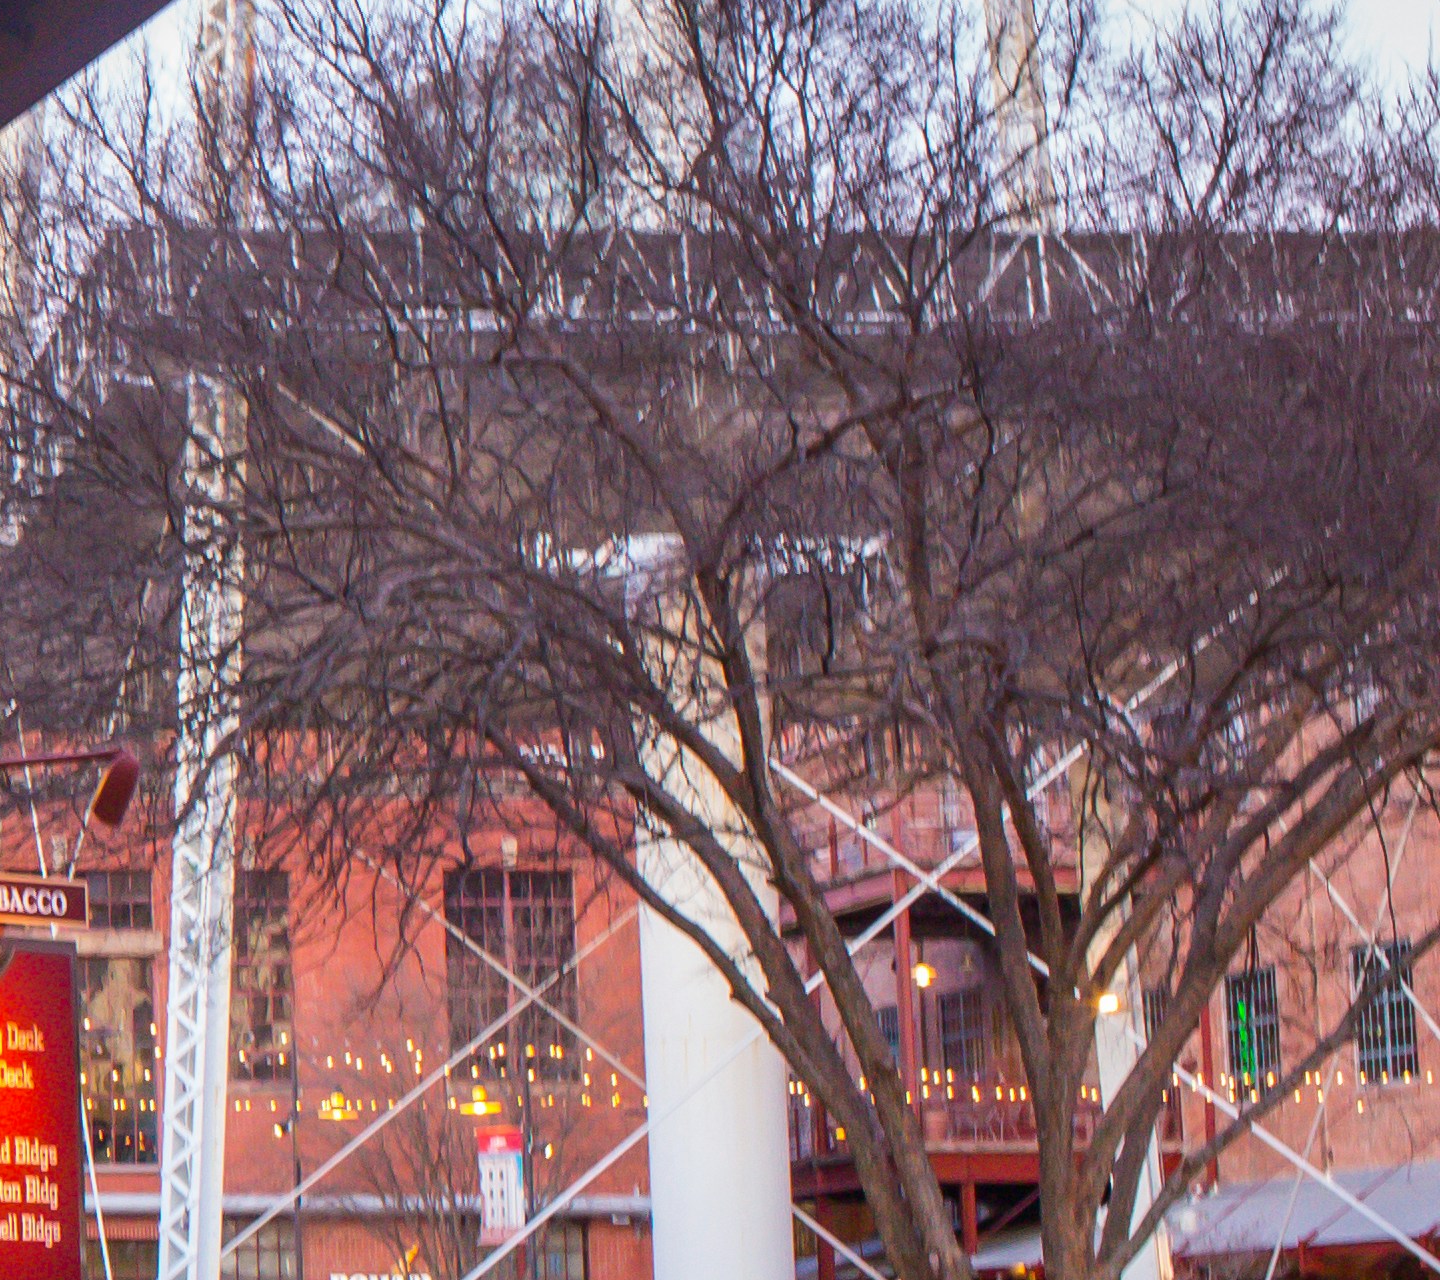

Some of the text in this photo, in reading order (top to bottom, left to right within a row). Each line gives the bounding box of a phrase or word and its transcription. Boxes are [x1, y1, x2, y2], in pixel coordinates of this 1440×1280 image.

[6, 1021, 46, 1052] Deck
[14, 1136, 58, 1172] Bldgs
[25, 1174, 59, 1211] Bldg
[21, 1213, 62, 1249] Bldgs
